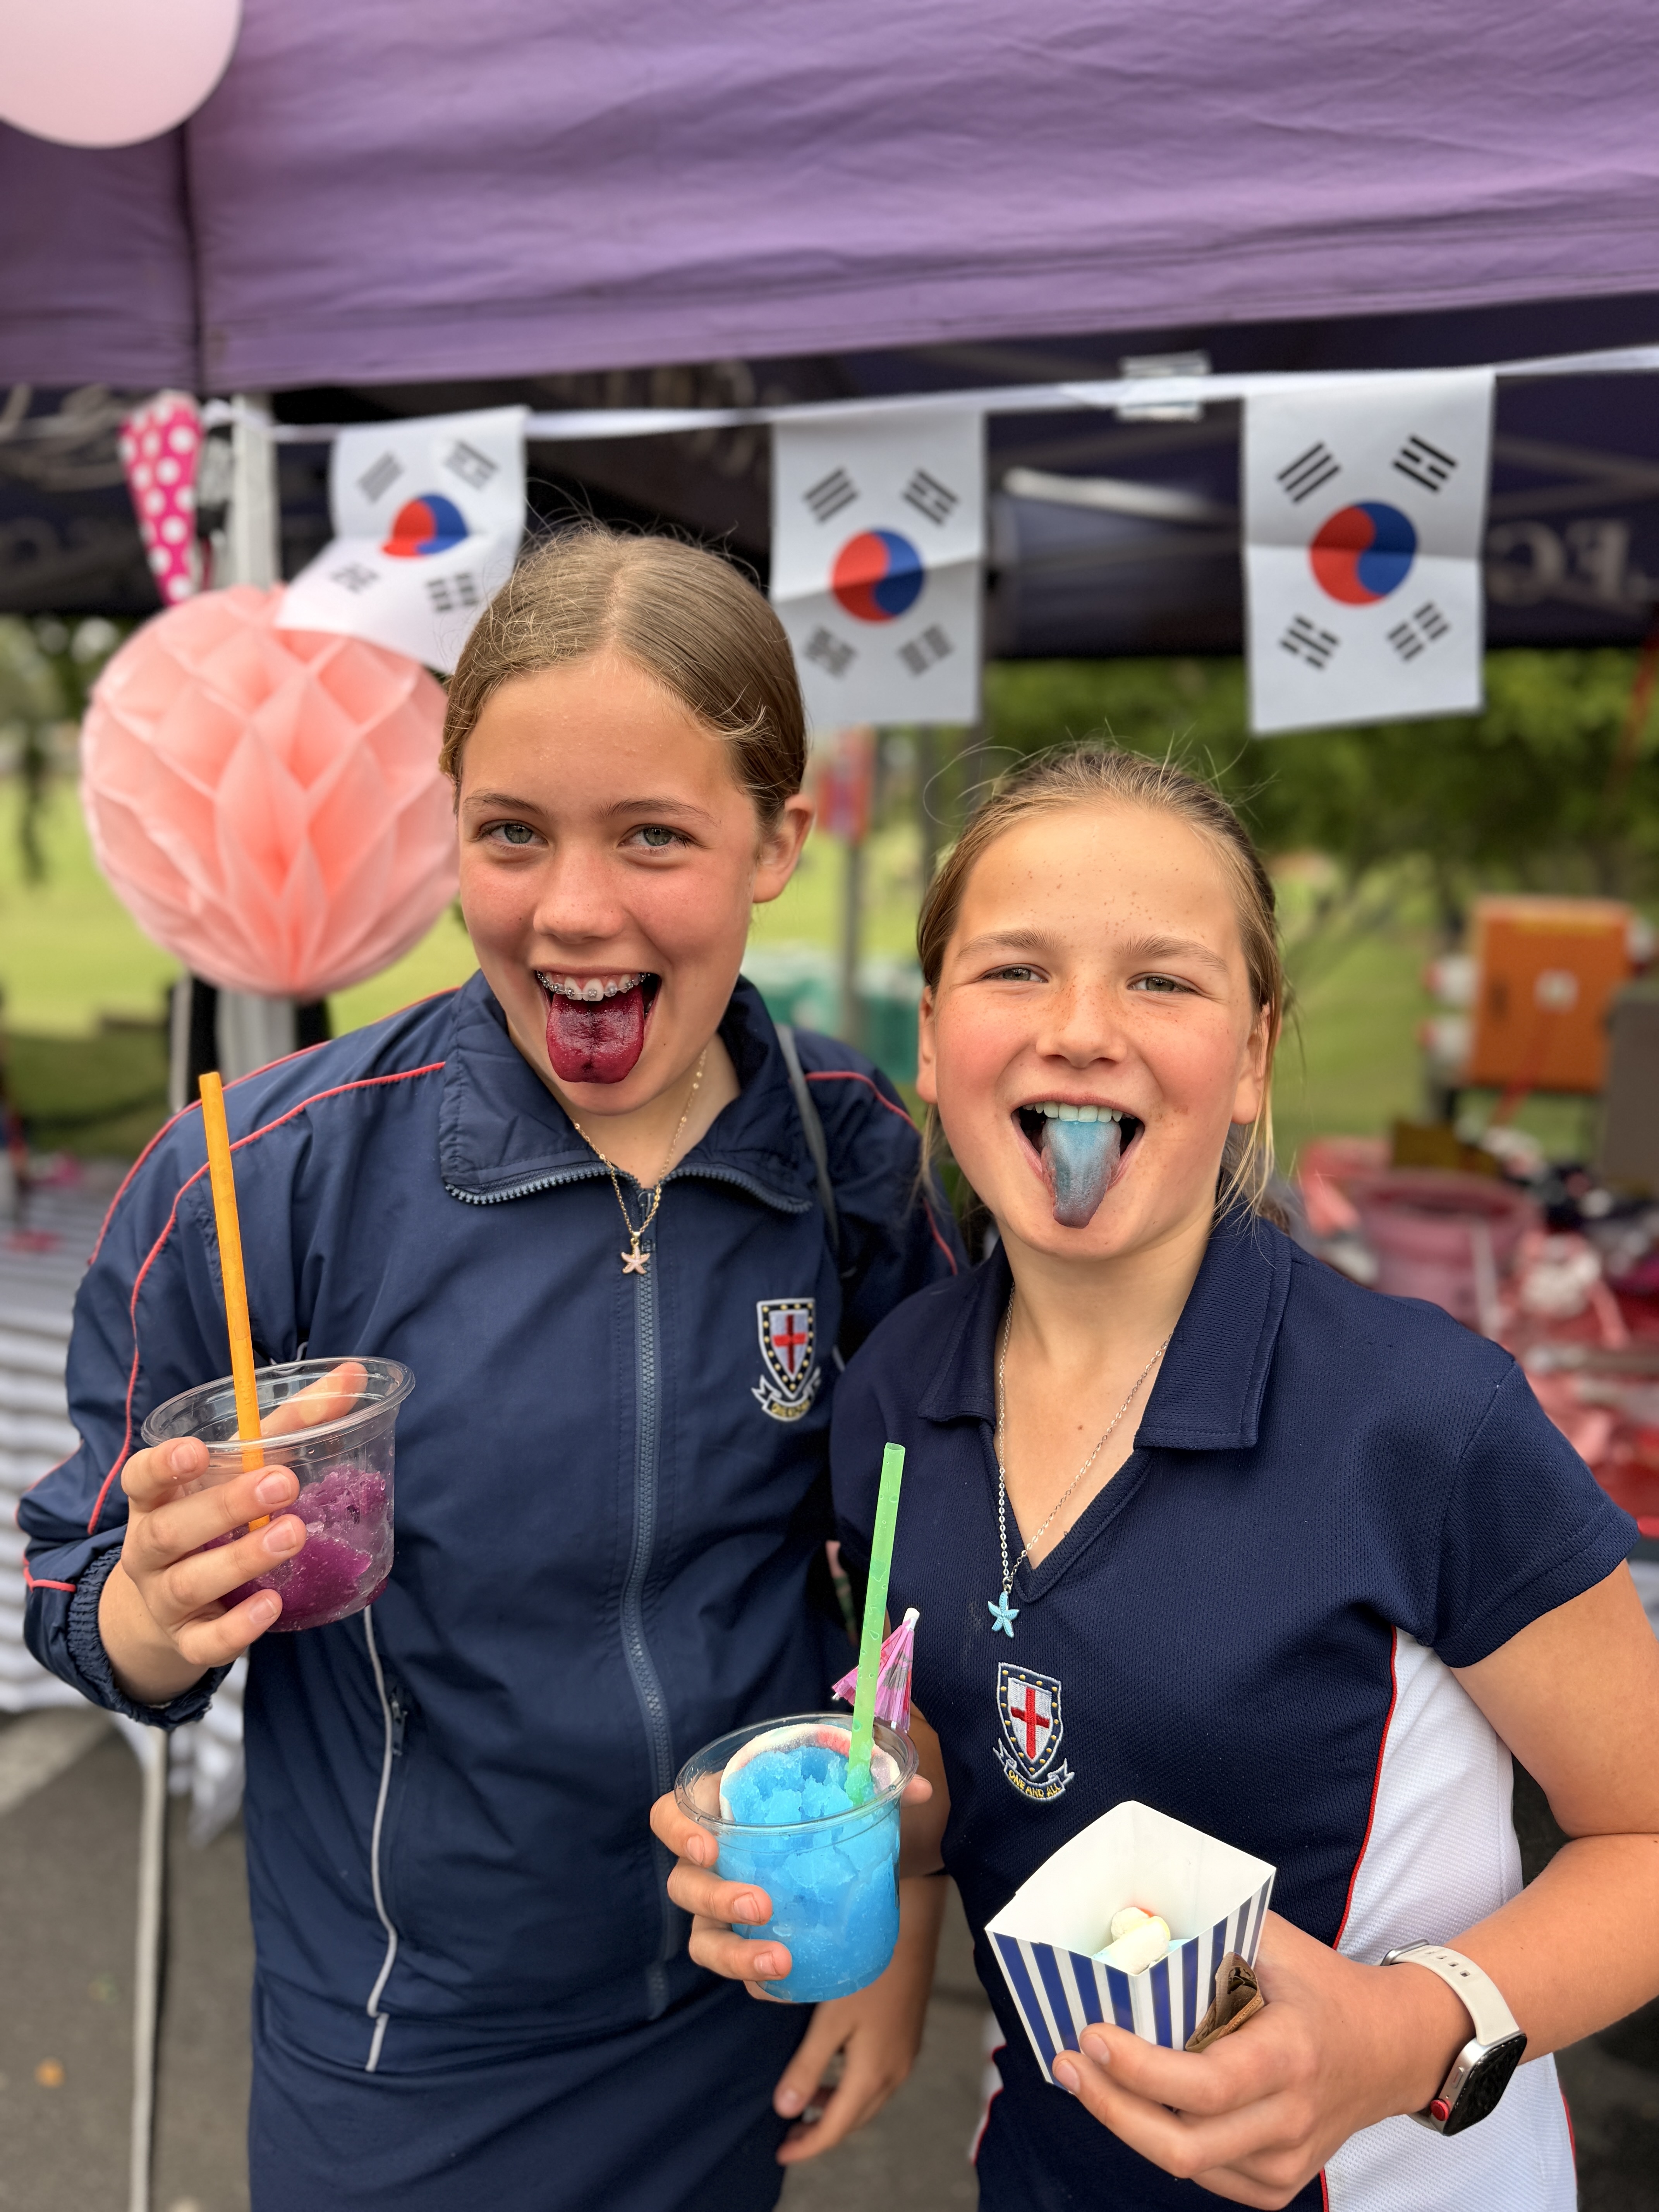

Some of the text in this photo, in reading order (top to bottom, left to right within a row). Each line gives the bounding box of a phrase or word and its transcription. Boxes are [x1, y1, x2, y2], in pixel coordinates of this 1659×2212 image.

[1009, 1770, 1061, 1798] ONE AND ALL
